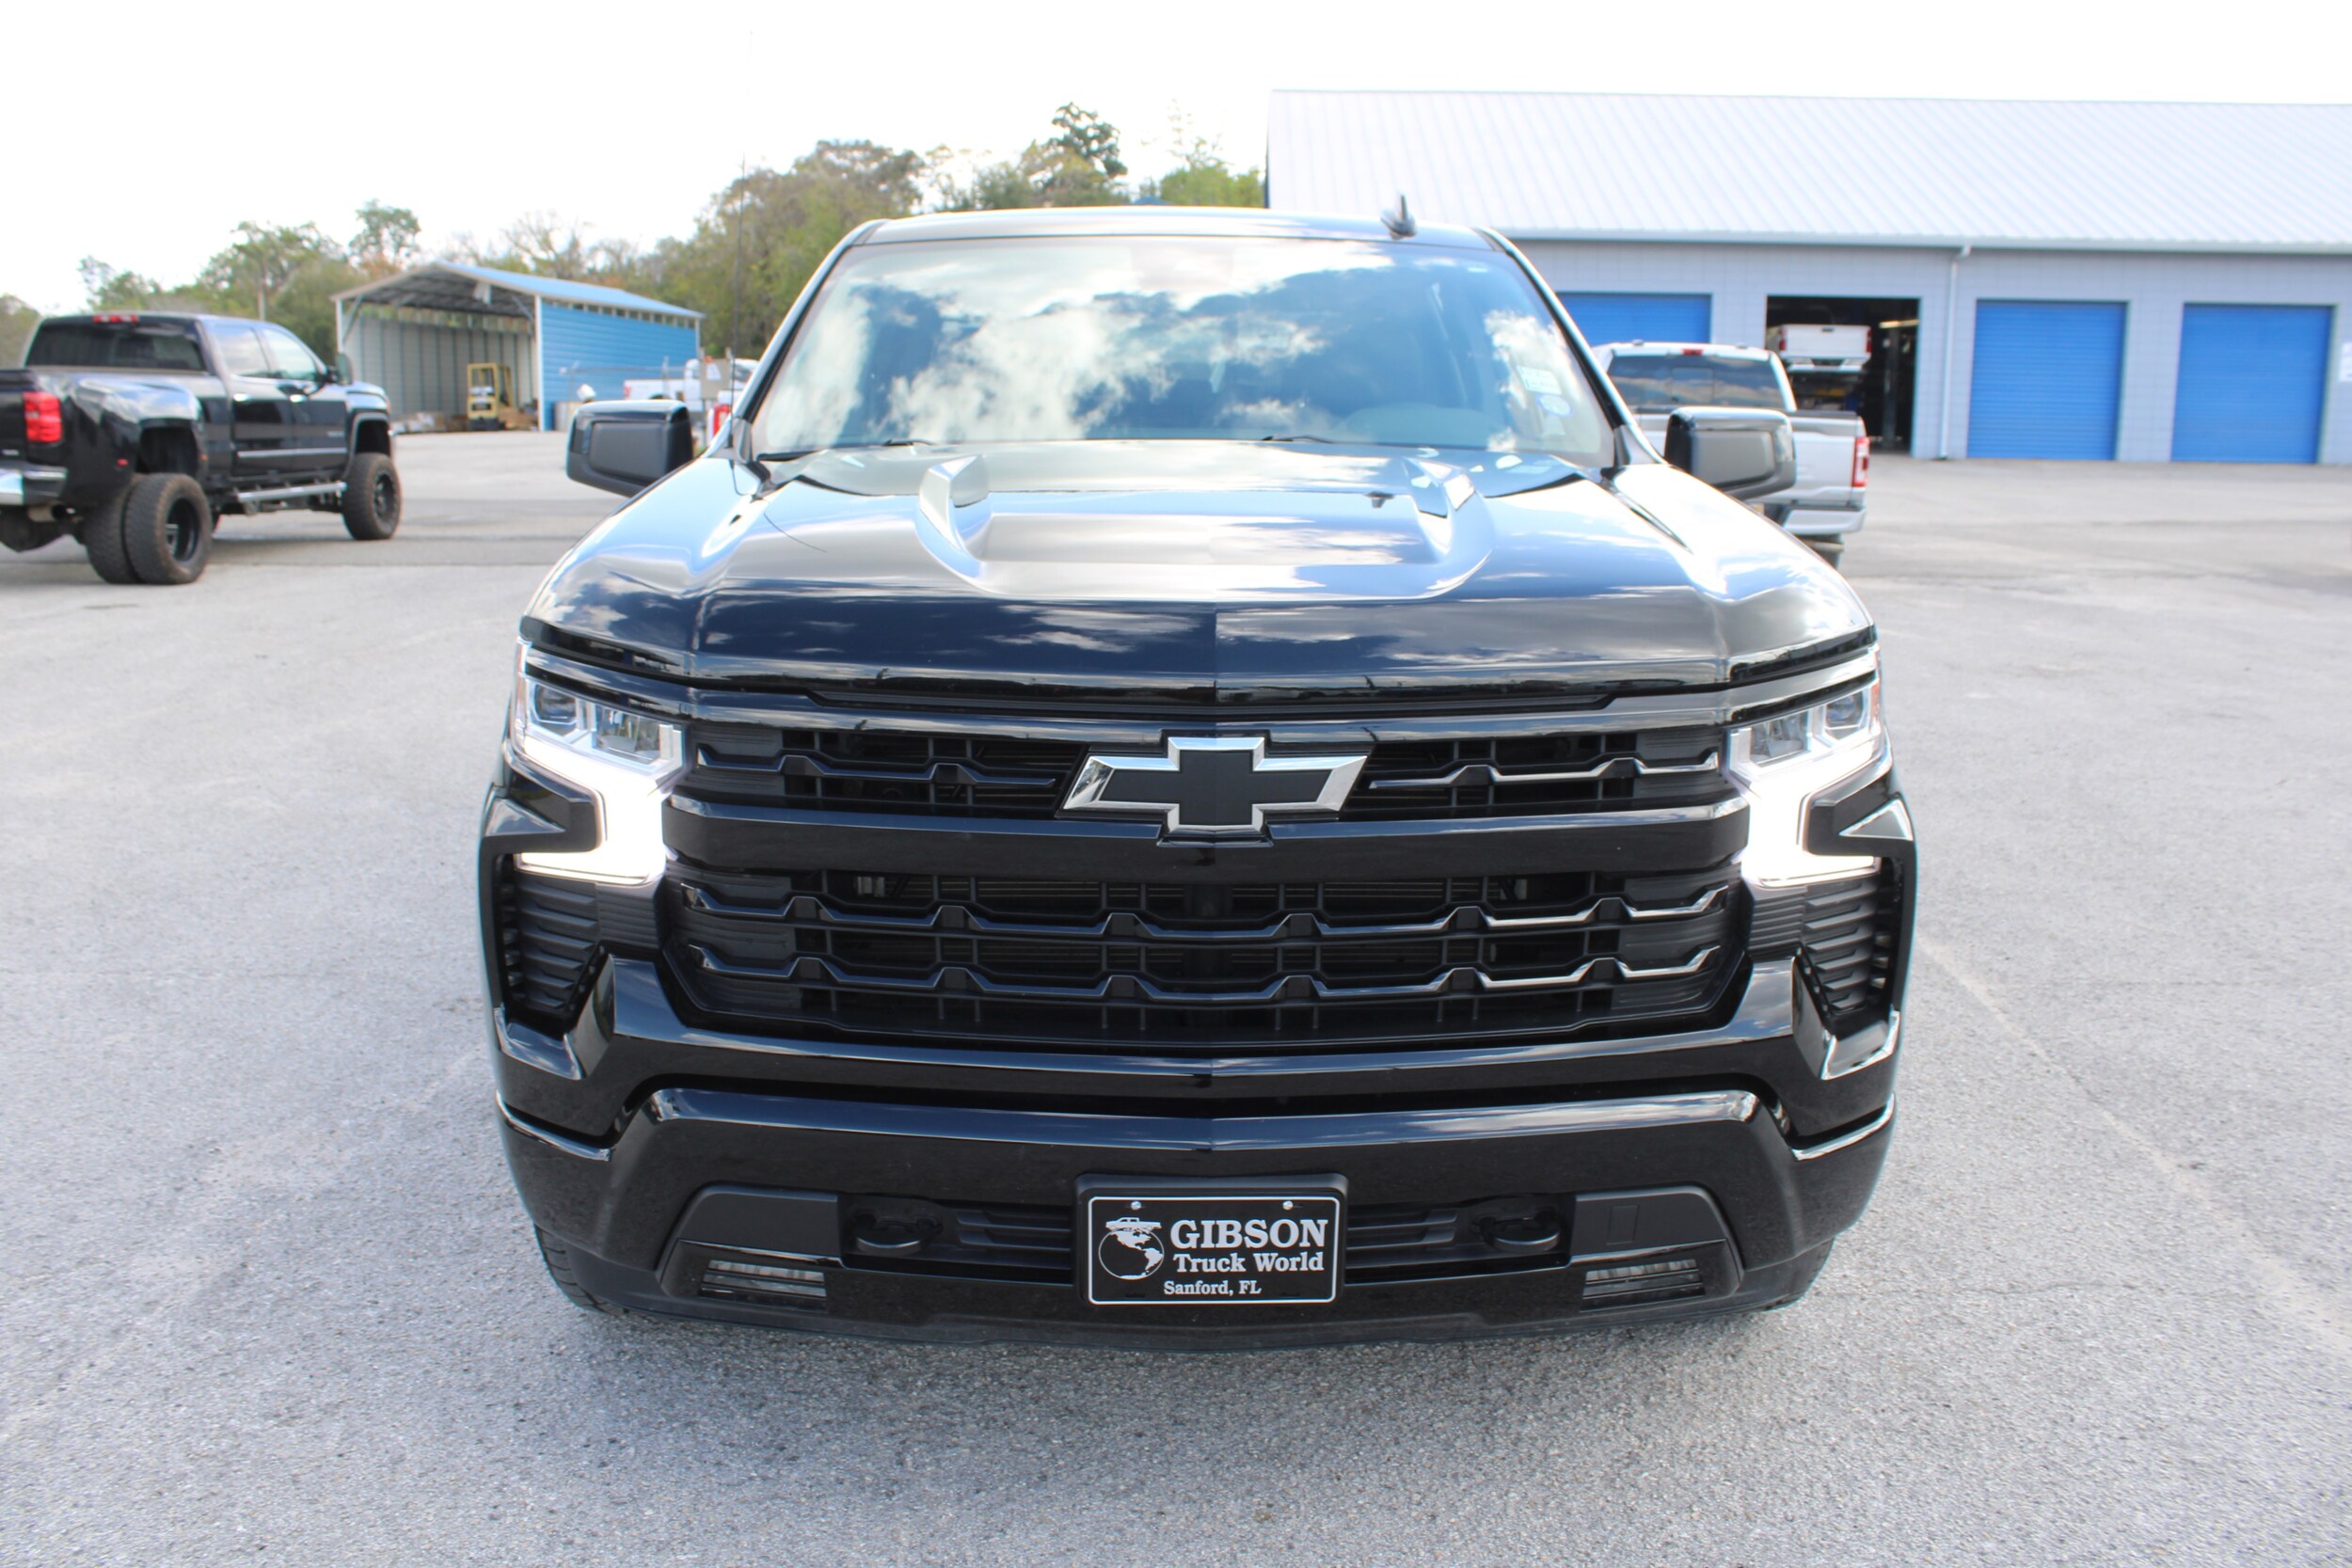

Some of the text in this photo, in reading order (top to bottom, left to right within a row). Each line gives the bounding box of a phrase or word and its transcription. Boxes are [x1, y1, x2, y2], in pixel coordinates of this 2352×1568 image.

[1170, 1219, 1327, 1248] GIBSON
[1173, 1252, 1324, 1272] Truck World
[1164, 1280, 1262, 1296] Sanford, FL
